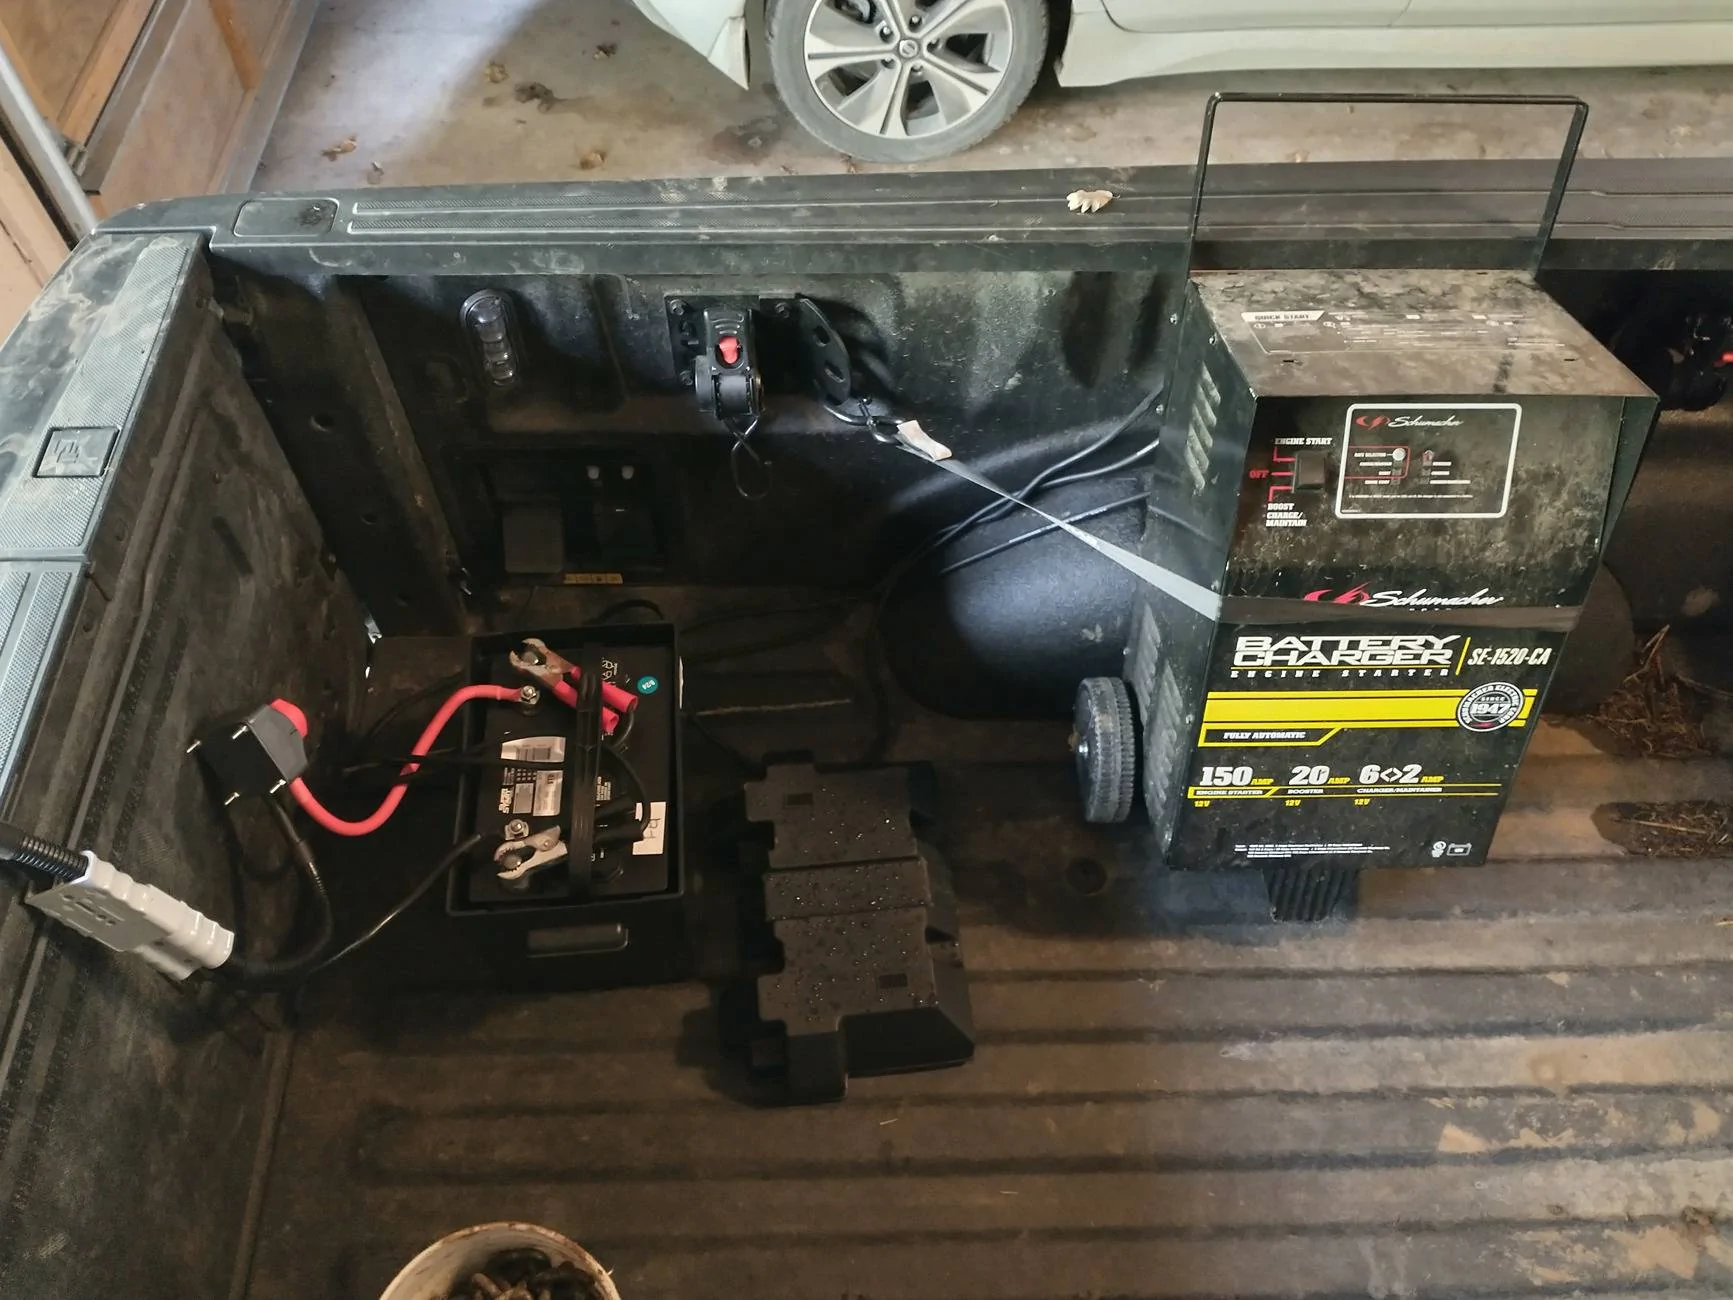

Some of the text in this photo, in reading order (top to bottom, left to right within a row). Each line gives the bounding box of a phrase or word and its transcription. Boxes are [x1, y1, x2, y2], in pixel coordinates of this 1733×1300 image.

[1275, 437, 1333, 446] ENGINE START
[1249, 469, 1270, 478] OFF
[1267, 503, 1295, 511] BOOST
[1265, 519, 1307, 527] MAINTAIN
[1359, 588, 1504, 608] Schumacher
[1235, 634, 1462, 651] BATTERY
[1233, 650, 1453, 667] CHARGER
[1467, 647, 1553, 666] SE-1520-CA
[1230, 669, 1450, 679] ENGINE STARTER
[1471, 702, 1511, 714] 1947
[1223, 730, 1307, 740] FULLY AUTOMATIC
[1200, 766, 1274, 786] 150 AMP
[1288, 765, 1351, 786] 20 AMP
[1420, 775, 1445, 784] AMP
[1194, 800, 1211, 808] 12V
[1284, 799, 1302, 807] 12V
[1354, 798, 1371, 806] 12V
